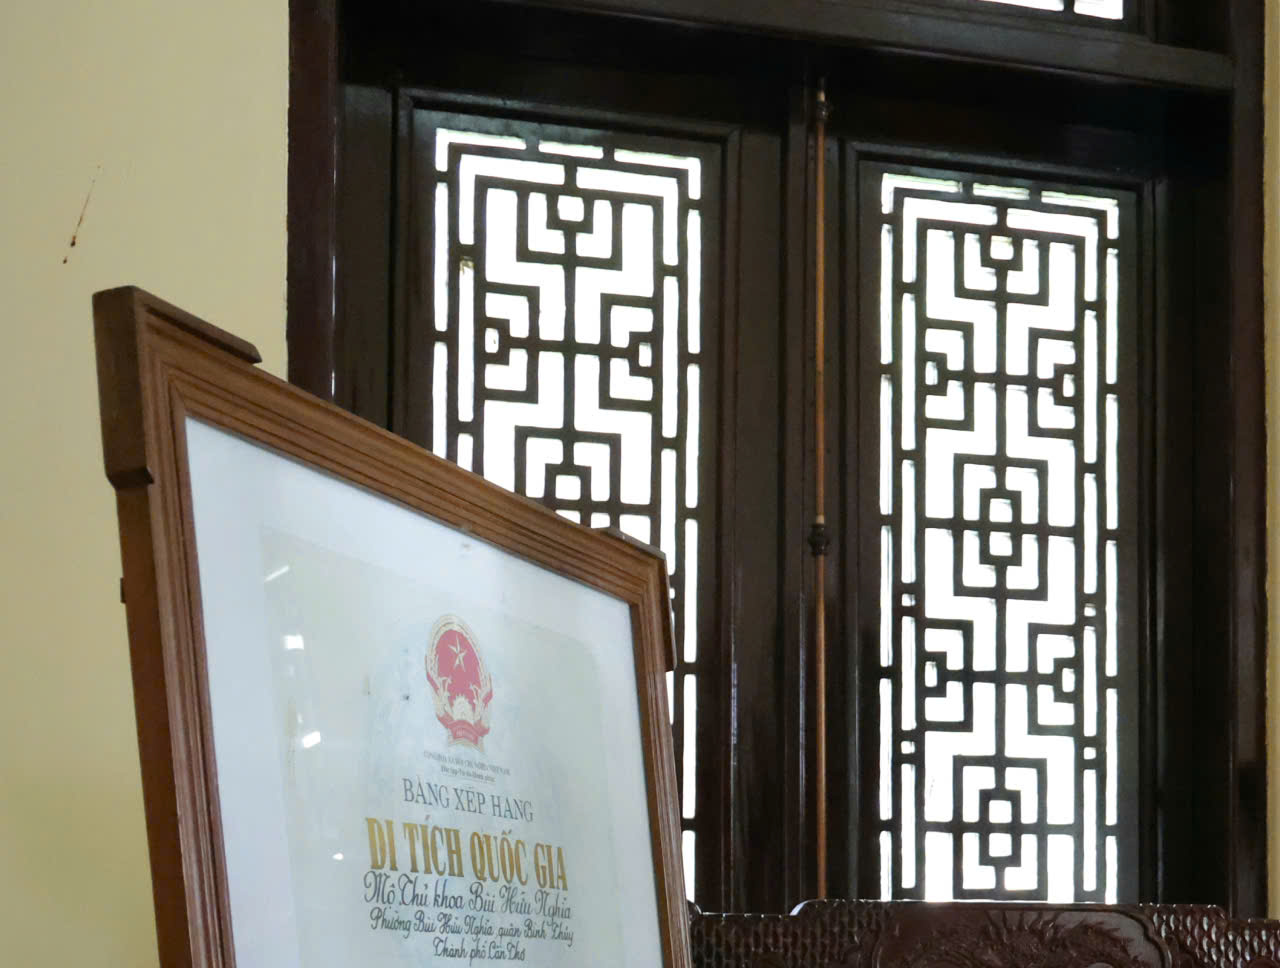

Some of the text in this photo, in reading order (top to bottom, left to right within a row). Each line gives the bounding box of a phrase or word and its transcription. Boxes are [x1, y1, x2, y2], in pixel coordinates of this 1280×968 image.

[365, 814, 568, 891] DI TÍCH QUỐC GIA
[433, 878, 466, 910] khoa
